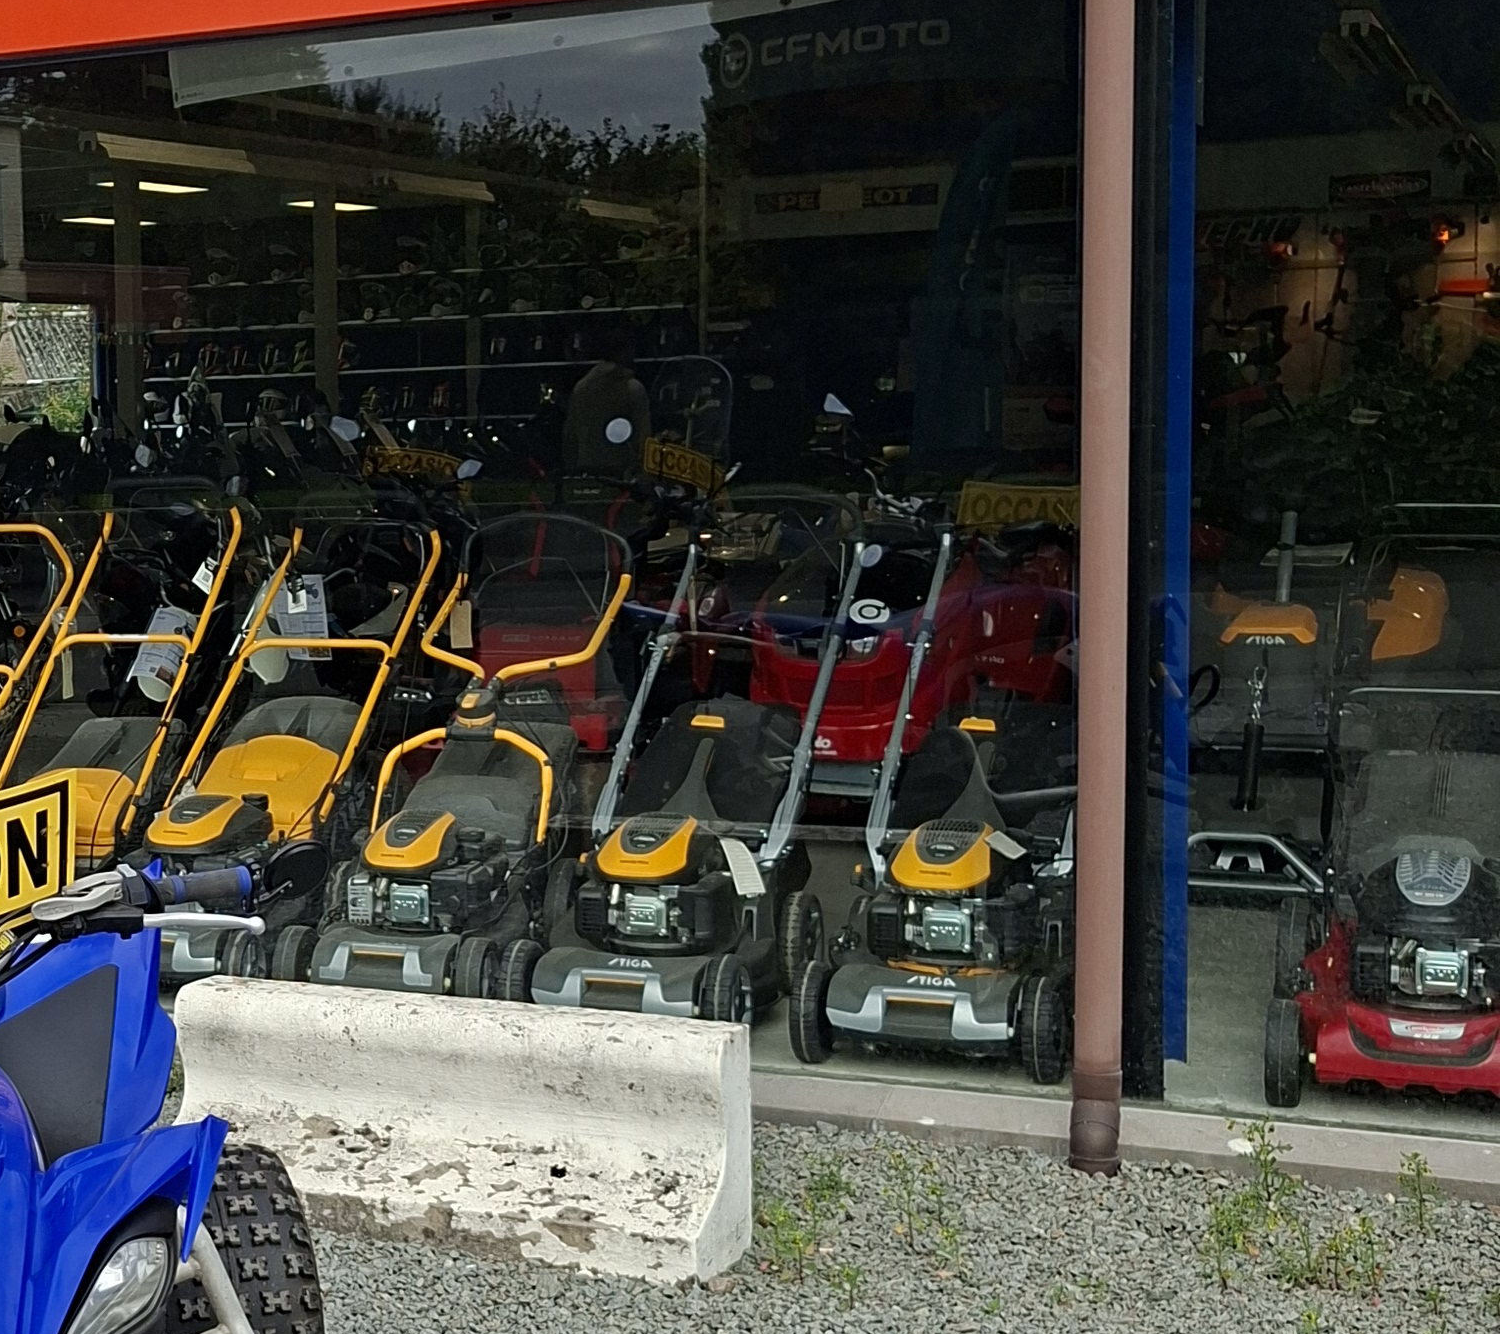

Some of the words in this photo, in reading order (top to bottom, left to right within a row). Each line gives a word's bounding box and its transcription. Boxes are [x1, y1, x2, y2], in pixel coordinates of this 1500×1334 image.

[760, 18, 951, 66] CFMOTO
[777, 187, 912, 211] PEEOT
[1245, 634, 1286, 646] STIGA
[608, 957, 653, 968] STIGA
[906, 975, 956, 987] STIGA
